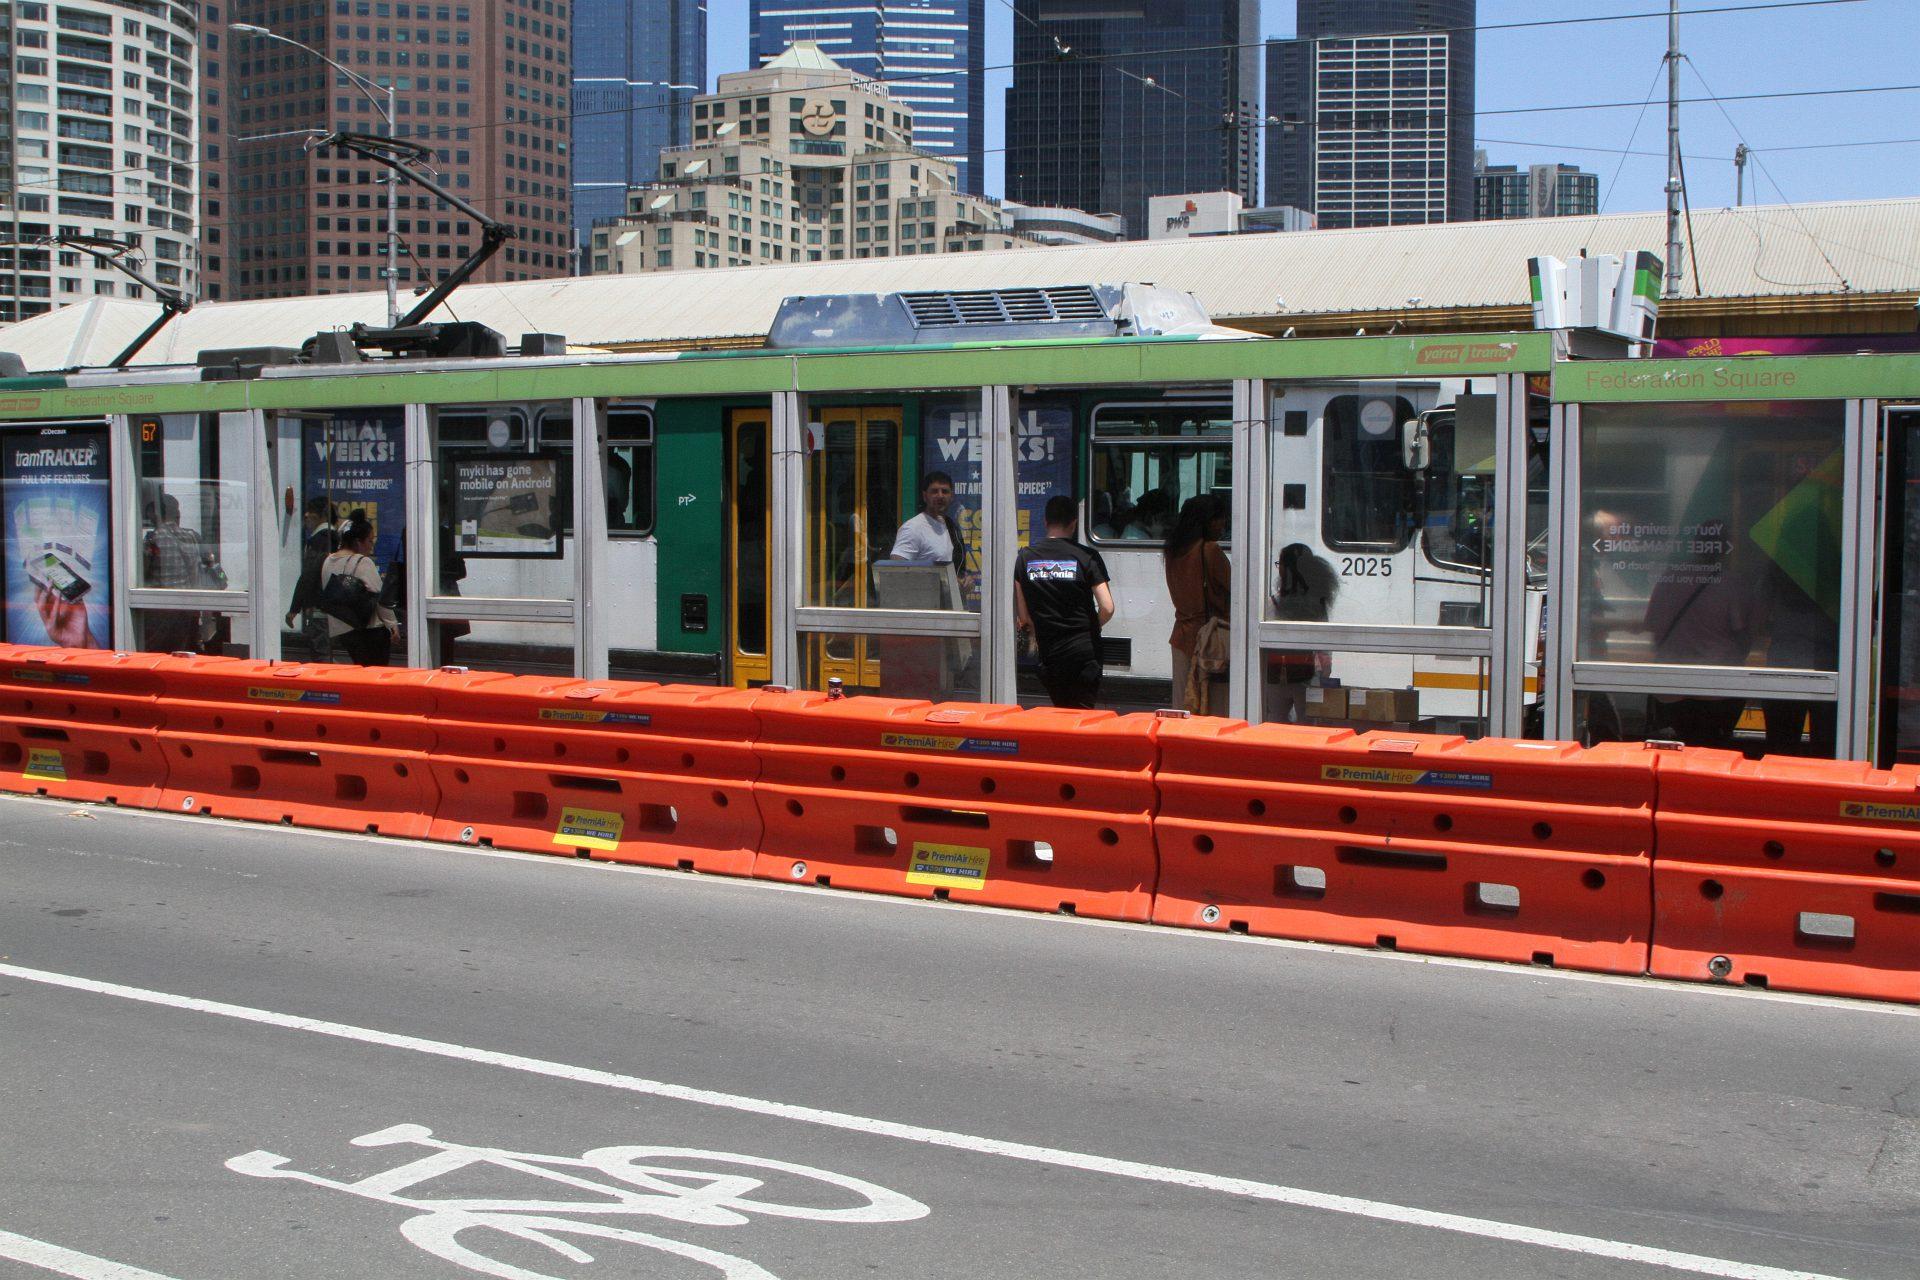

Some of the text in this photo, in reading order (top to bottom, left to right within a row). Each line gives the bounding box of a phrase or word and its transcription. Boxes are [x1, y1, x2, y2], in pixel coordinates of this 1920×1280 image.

[1424, 347, 1510, 362] yarra trams
[1586, 367, 1796, 390] Federation Square
[64, 391, 155, 408] Federation Square
[40, 428, 67, 436] JCDecaux
[142, 423, 156, 442] 67
[323, 418, 387, 441] FINAL
[314, 441, 395, 462] WEEKS!
[459, 464, 532, 479] myki has gone
[21, 473, 90, 485] FULL OF FEATURES
[459, 476, 552, 490] mobile on Android
[954, 482, 967, 495] HIT
[1341, 557, 1392, 577] 2025
[1029, 570, 1074, 581] patagonia
[898, 735, 937, 747] PremiAir
[1342, 768, 1390, 781] PremiAir
[1391, 771, 1414, 783] Hire
[597, 831, 614, 839] HIRE
[931, 851, 968, 863] PremiAir
[944, 866, 957, 874] WE
[958, 868, 978, 877] HIRE
